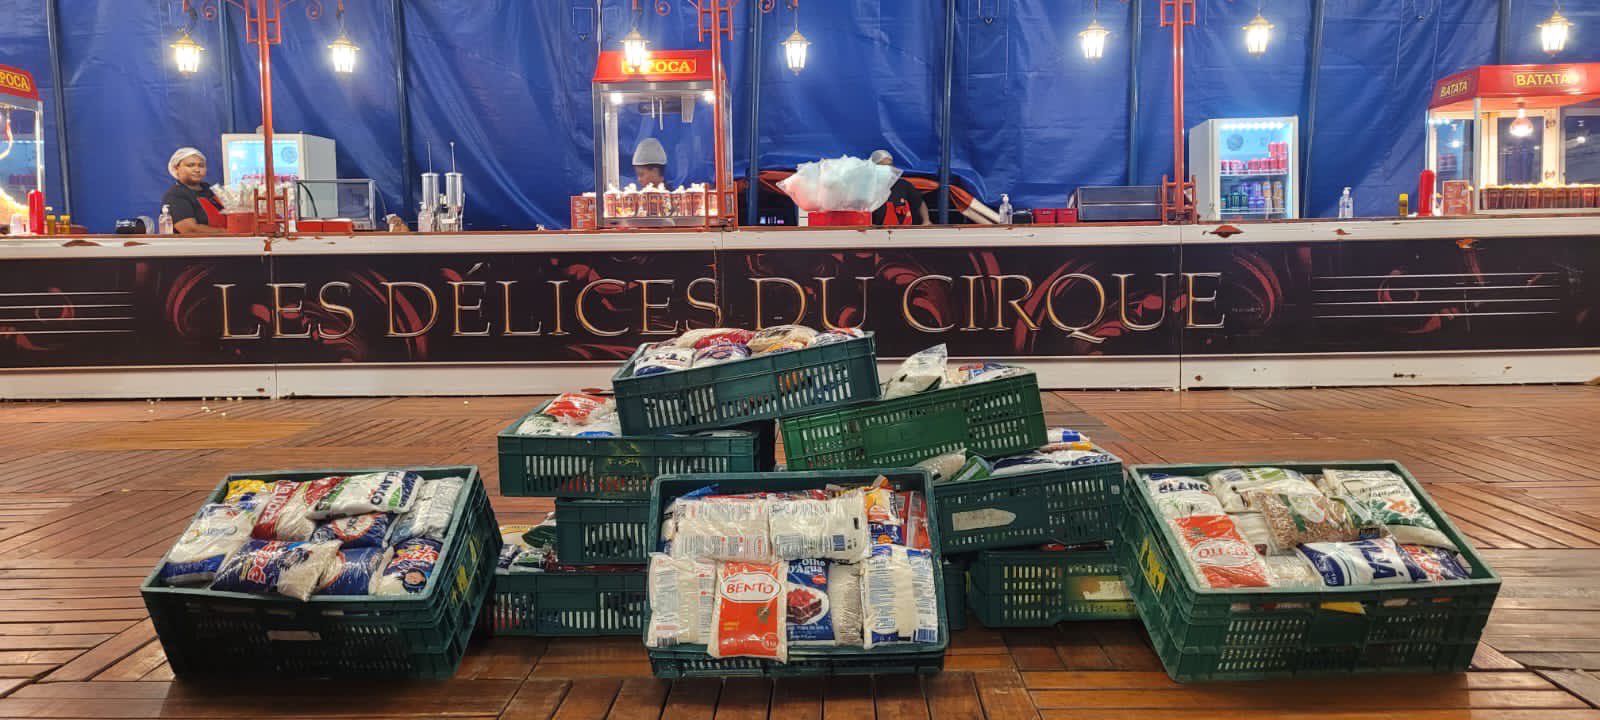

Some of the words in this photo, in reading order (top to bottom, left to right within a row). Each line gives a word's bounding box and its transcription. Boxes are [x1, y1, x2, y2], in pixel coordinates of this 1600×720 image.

[629, 61, 691, 73] POCA
[1515, 73, 1570, 86] BATATA
[1440, 80, 1468, 98] BATATA
[213, 281, 356, 340] LES
[381, 262, 722, 338] DÉLICES
[749, 275, 876, 333] DU
[902, 272, 1226, 344] CIRQUE
[726, 582, 775, 595] BENTO
